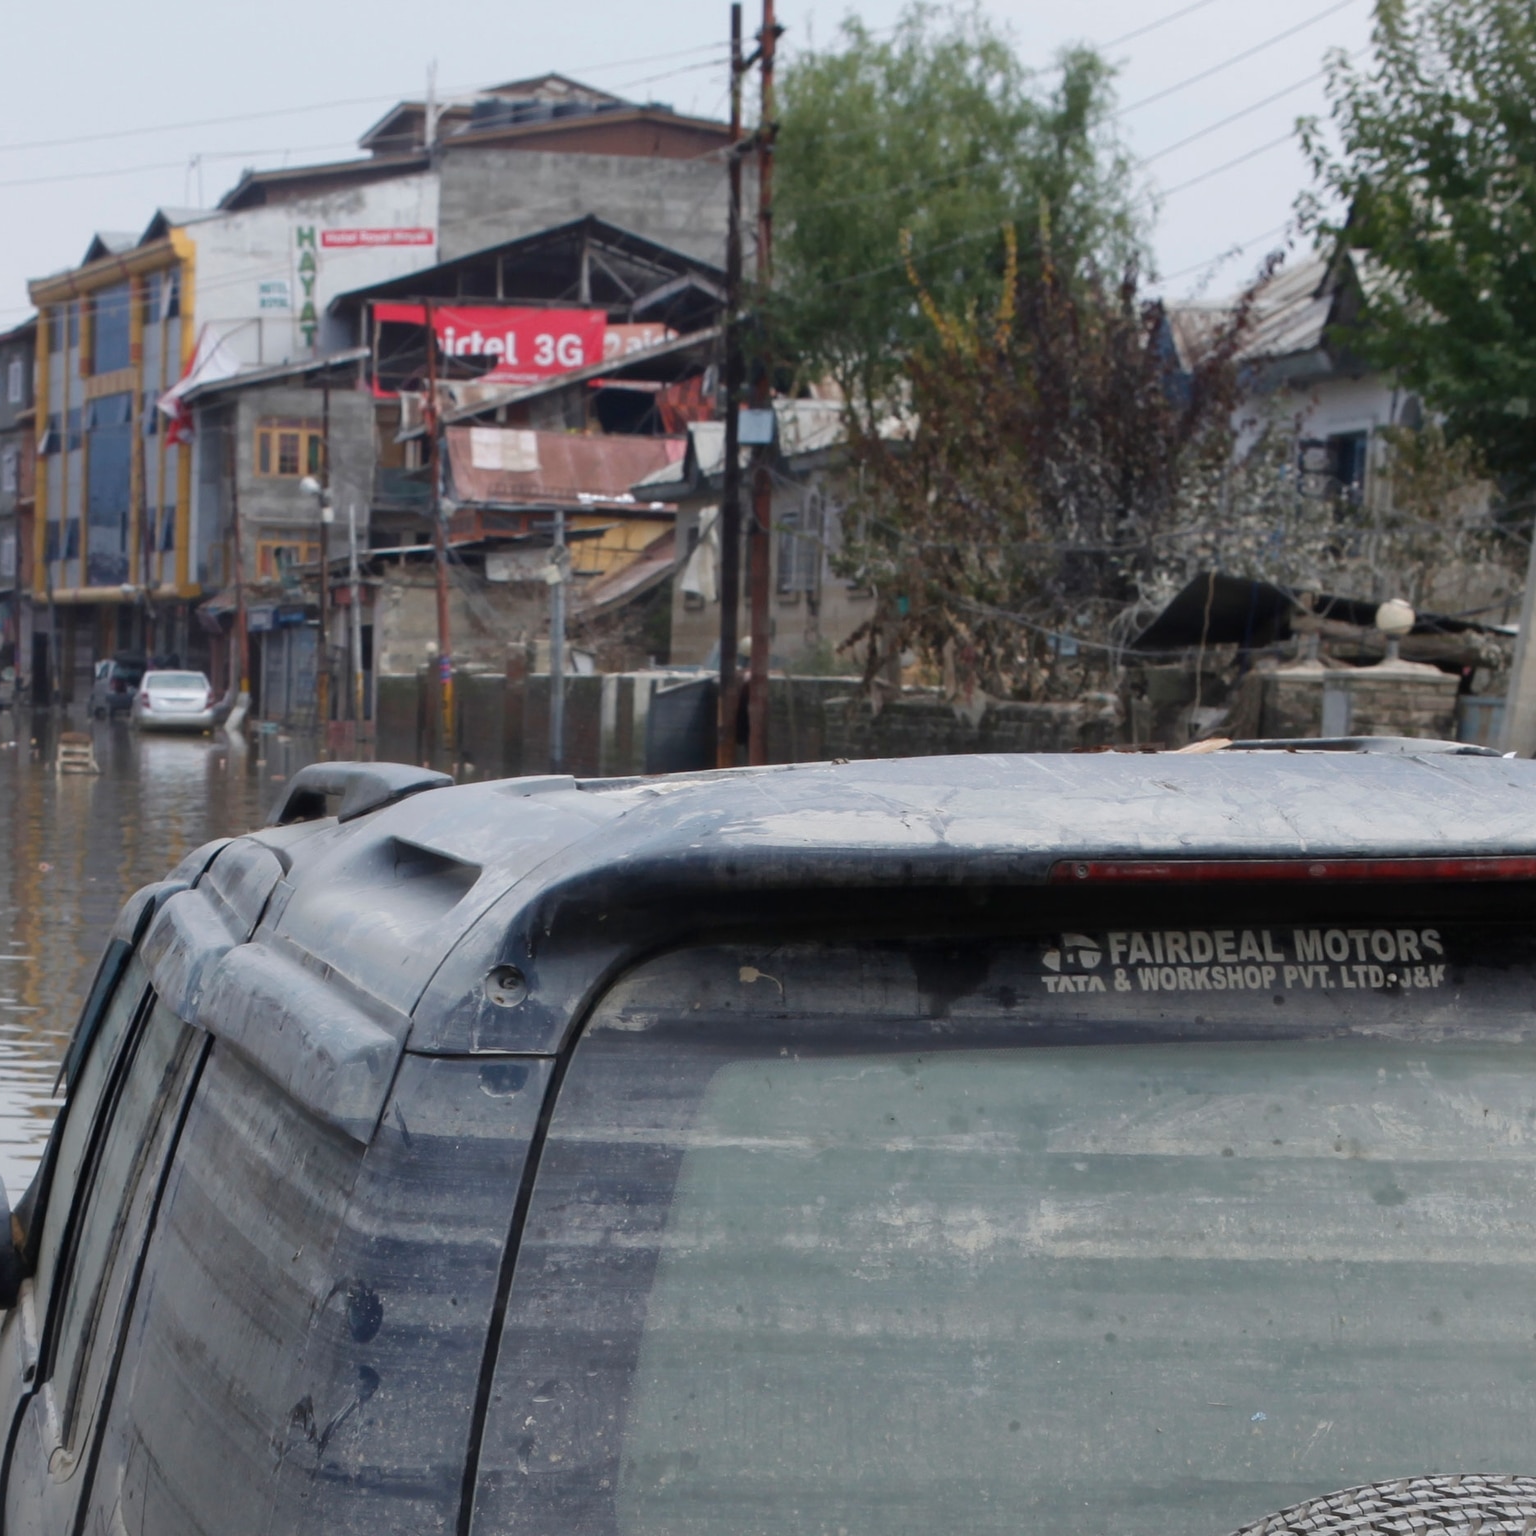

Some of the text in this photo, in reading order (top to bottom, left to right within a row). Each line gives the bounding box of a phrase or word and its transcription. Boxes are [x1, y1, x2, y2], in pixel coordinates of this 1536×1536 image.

[297, 225, 317, 348] HAYAT
[436, 326, 583, 367] irtel 3G
[1107, 927, 1444, 965] FAIRDEAL MOTORS
[1041, 975, 1107, 993] TATA
[1113, 968, 1132, 993] &
[1137, 965, 1277, 992] WORKSHOP
